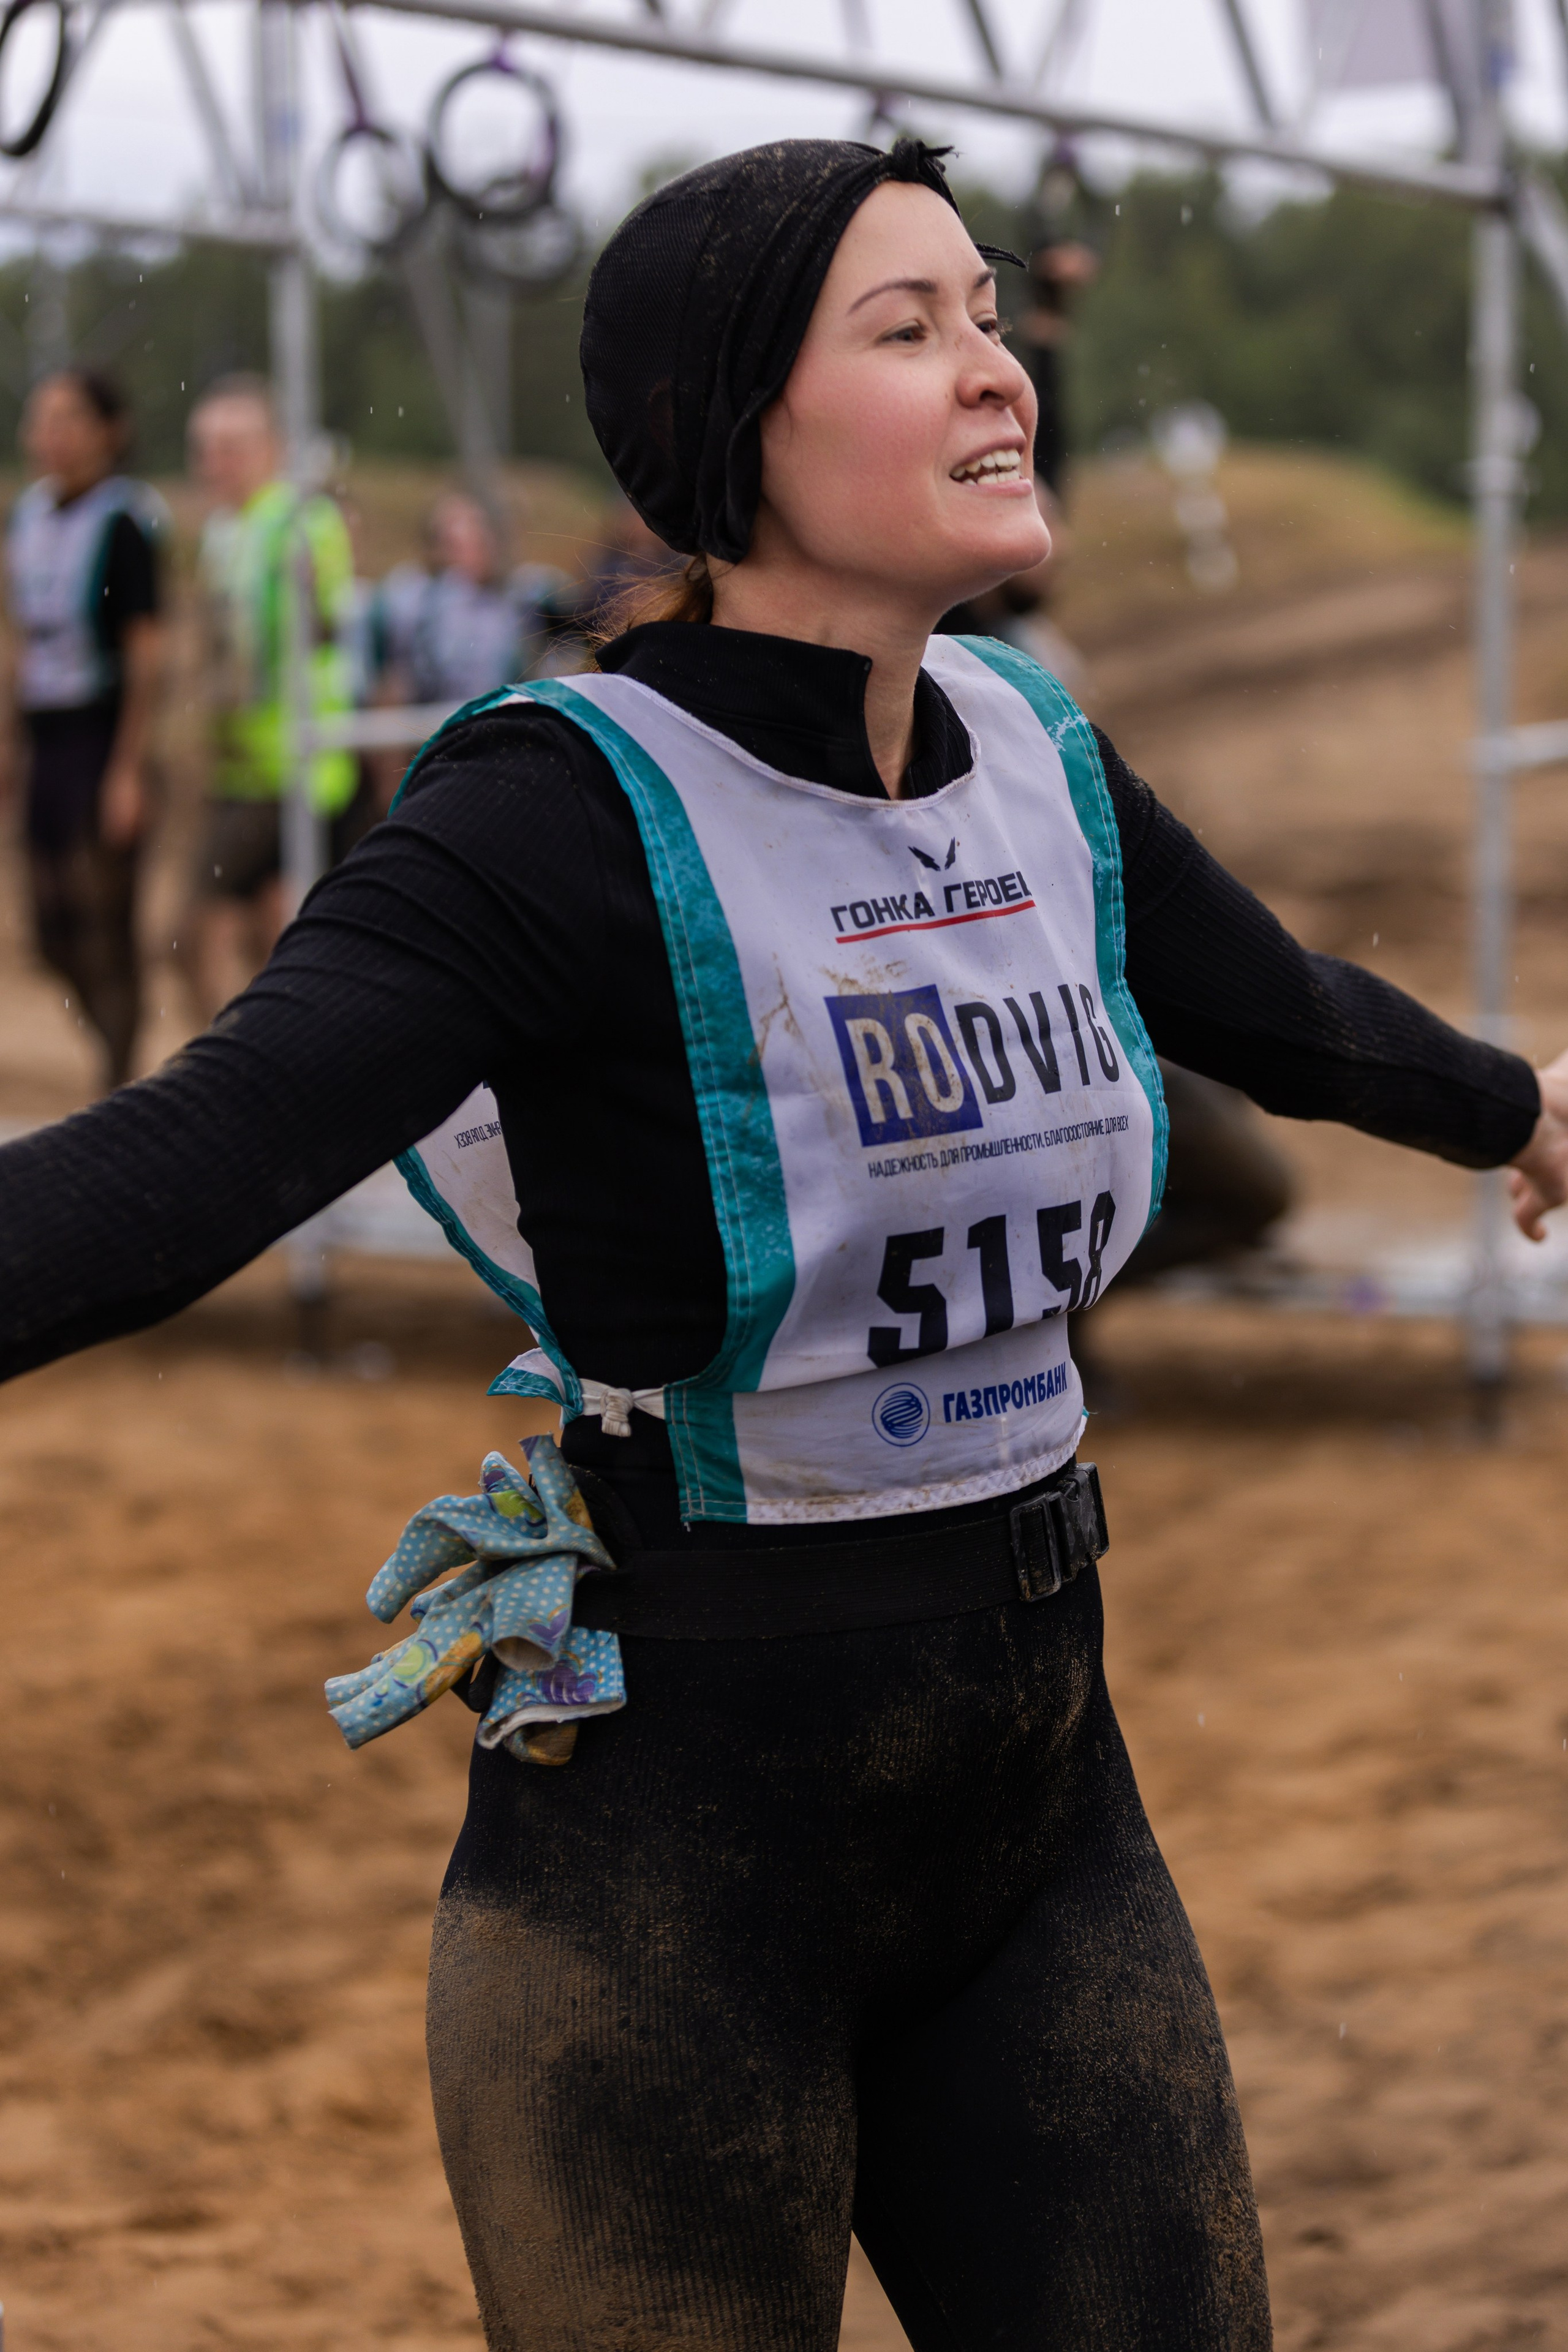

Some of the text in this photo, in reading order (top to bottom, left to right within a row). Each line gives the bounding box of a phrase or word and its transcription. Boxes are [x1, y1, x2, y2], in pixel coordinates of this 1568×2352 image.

[831, 891, 935, 932] ГОНКА
[845, 984, 1120, 1125] RODVIG
[867, 1115, 1129, 1178] НАДЕЖНОСТЬ ДЛЯ ПРОМЫШЛЕННОСТИ, БЛАГОСОСТОЯНИЕ ДЛЯ ВСЕХ
[867, 1190, 1116, 1368] 5158
[943, 1361, 1068, 1423] ГАЗПРОМБАНК
